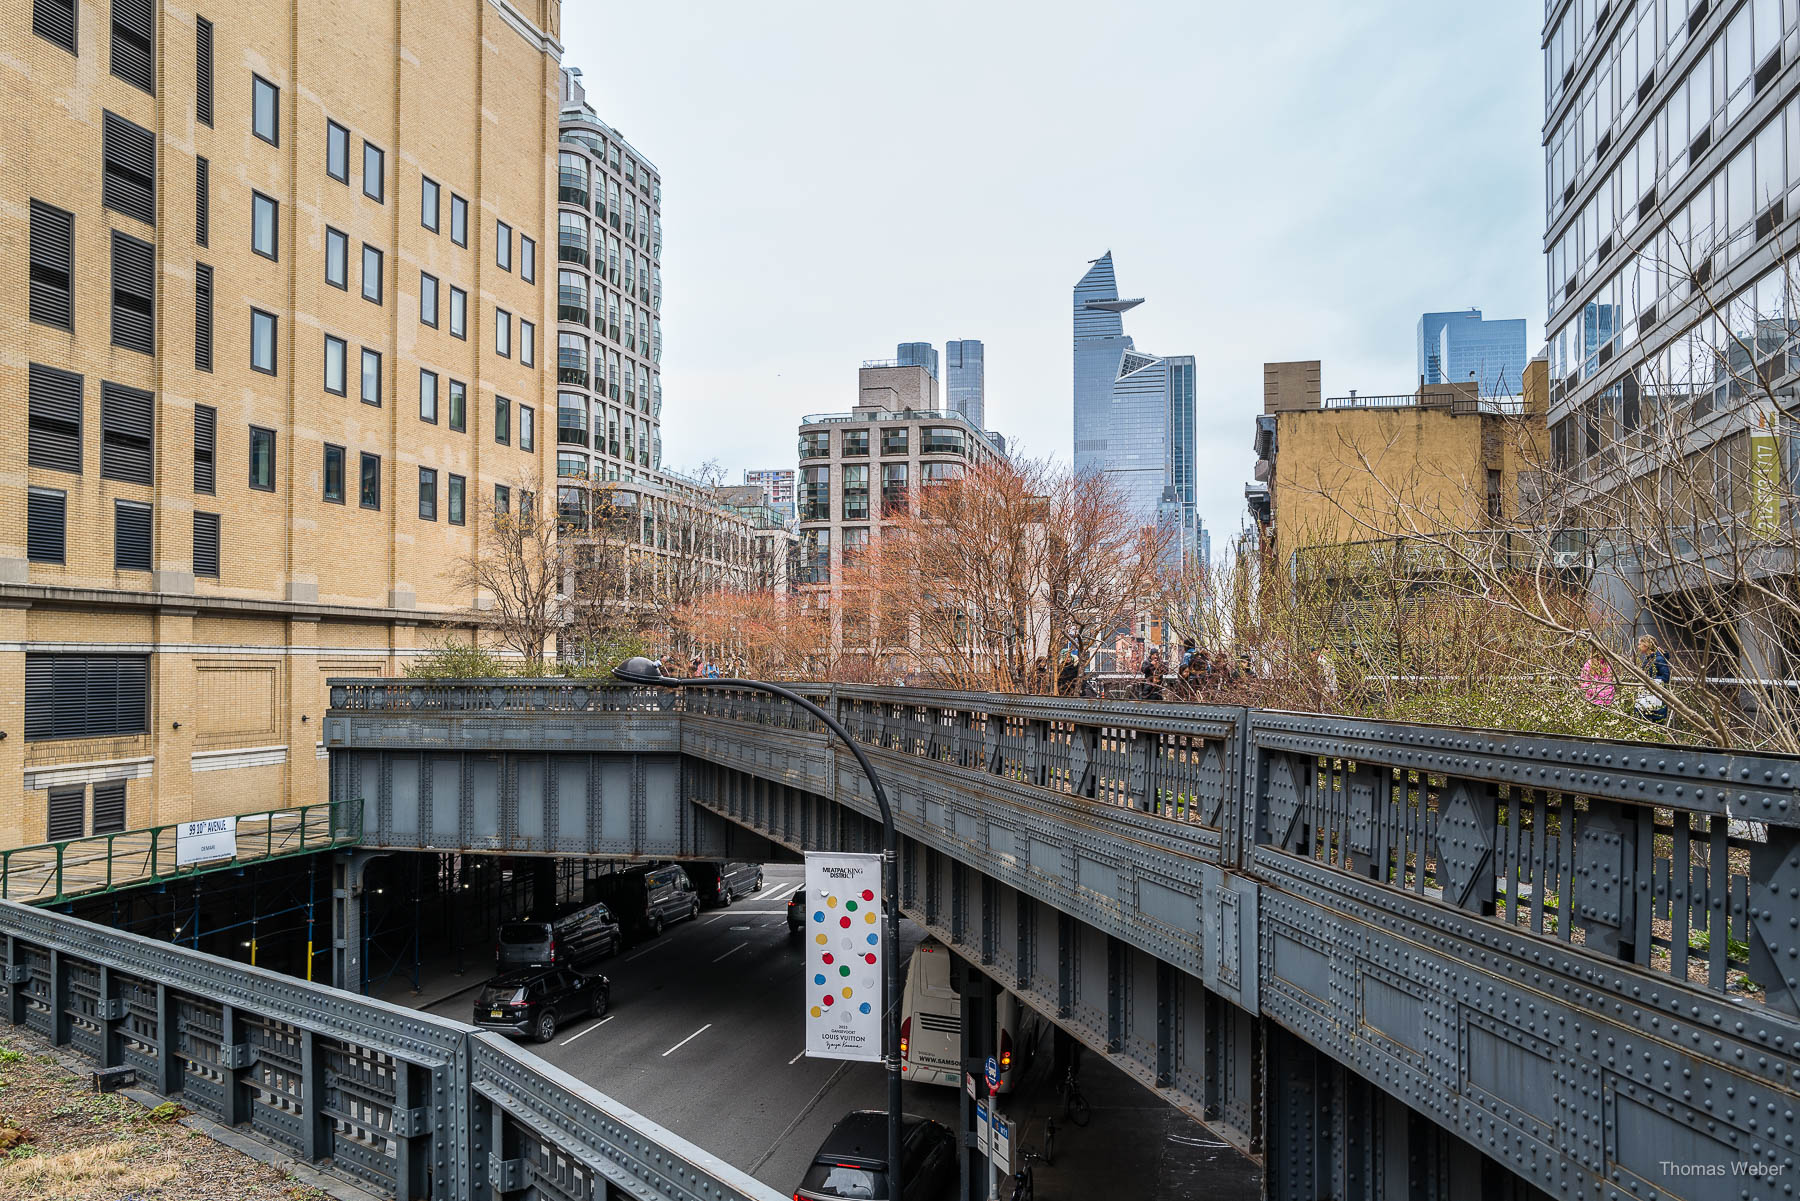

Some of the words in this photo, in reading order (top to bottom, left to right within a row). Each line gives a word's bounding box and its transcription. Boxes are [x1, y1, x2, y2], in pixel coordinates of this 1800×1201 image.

[189, 824, 196, 835] 99
[207, 820, 226, 832] AVENUE
[919, 1056, 961, 1066] WWW.SAMSO
